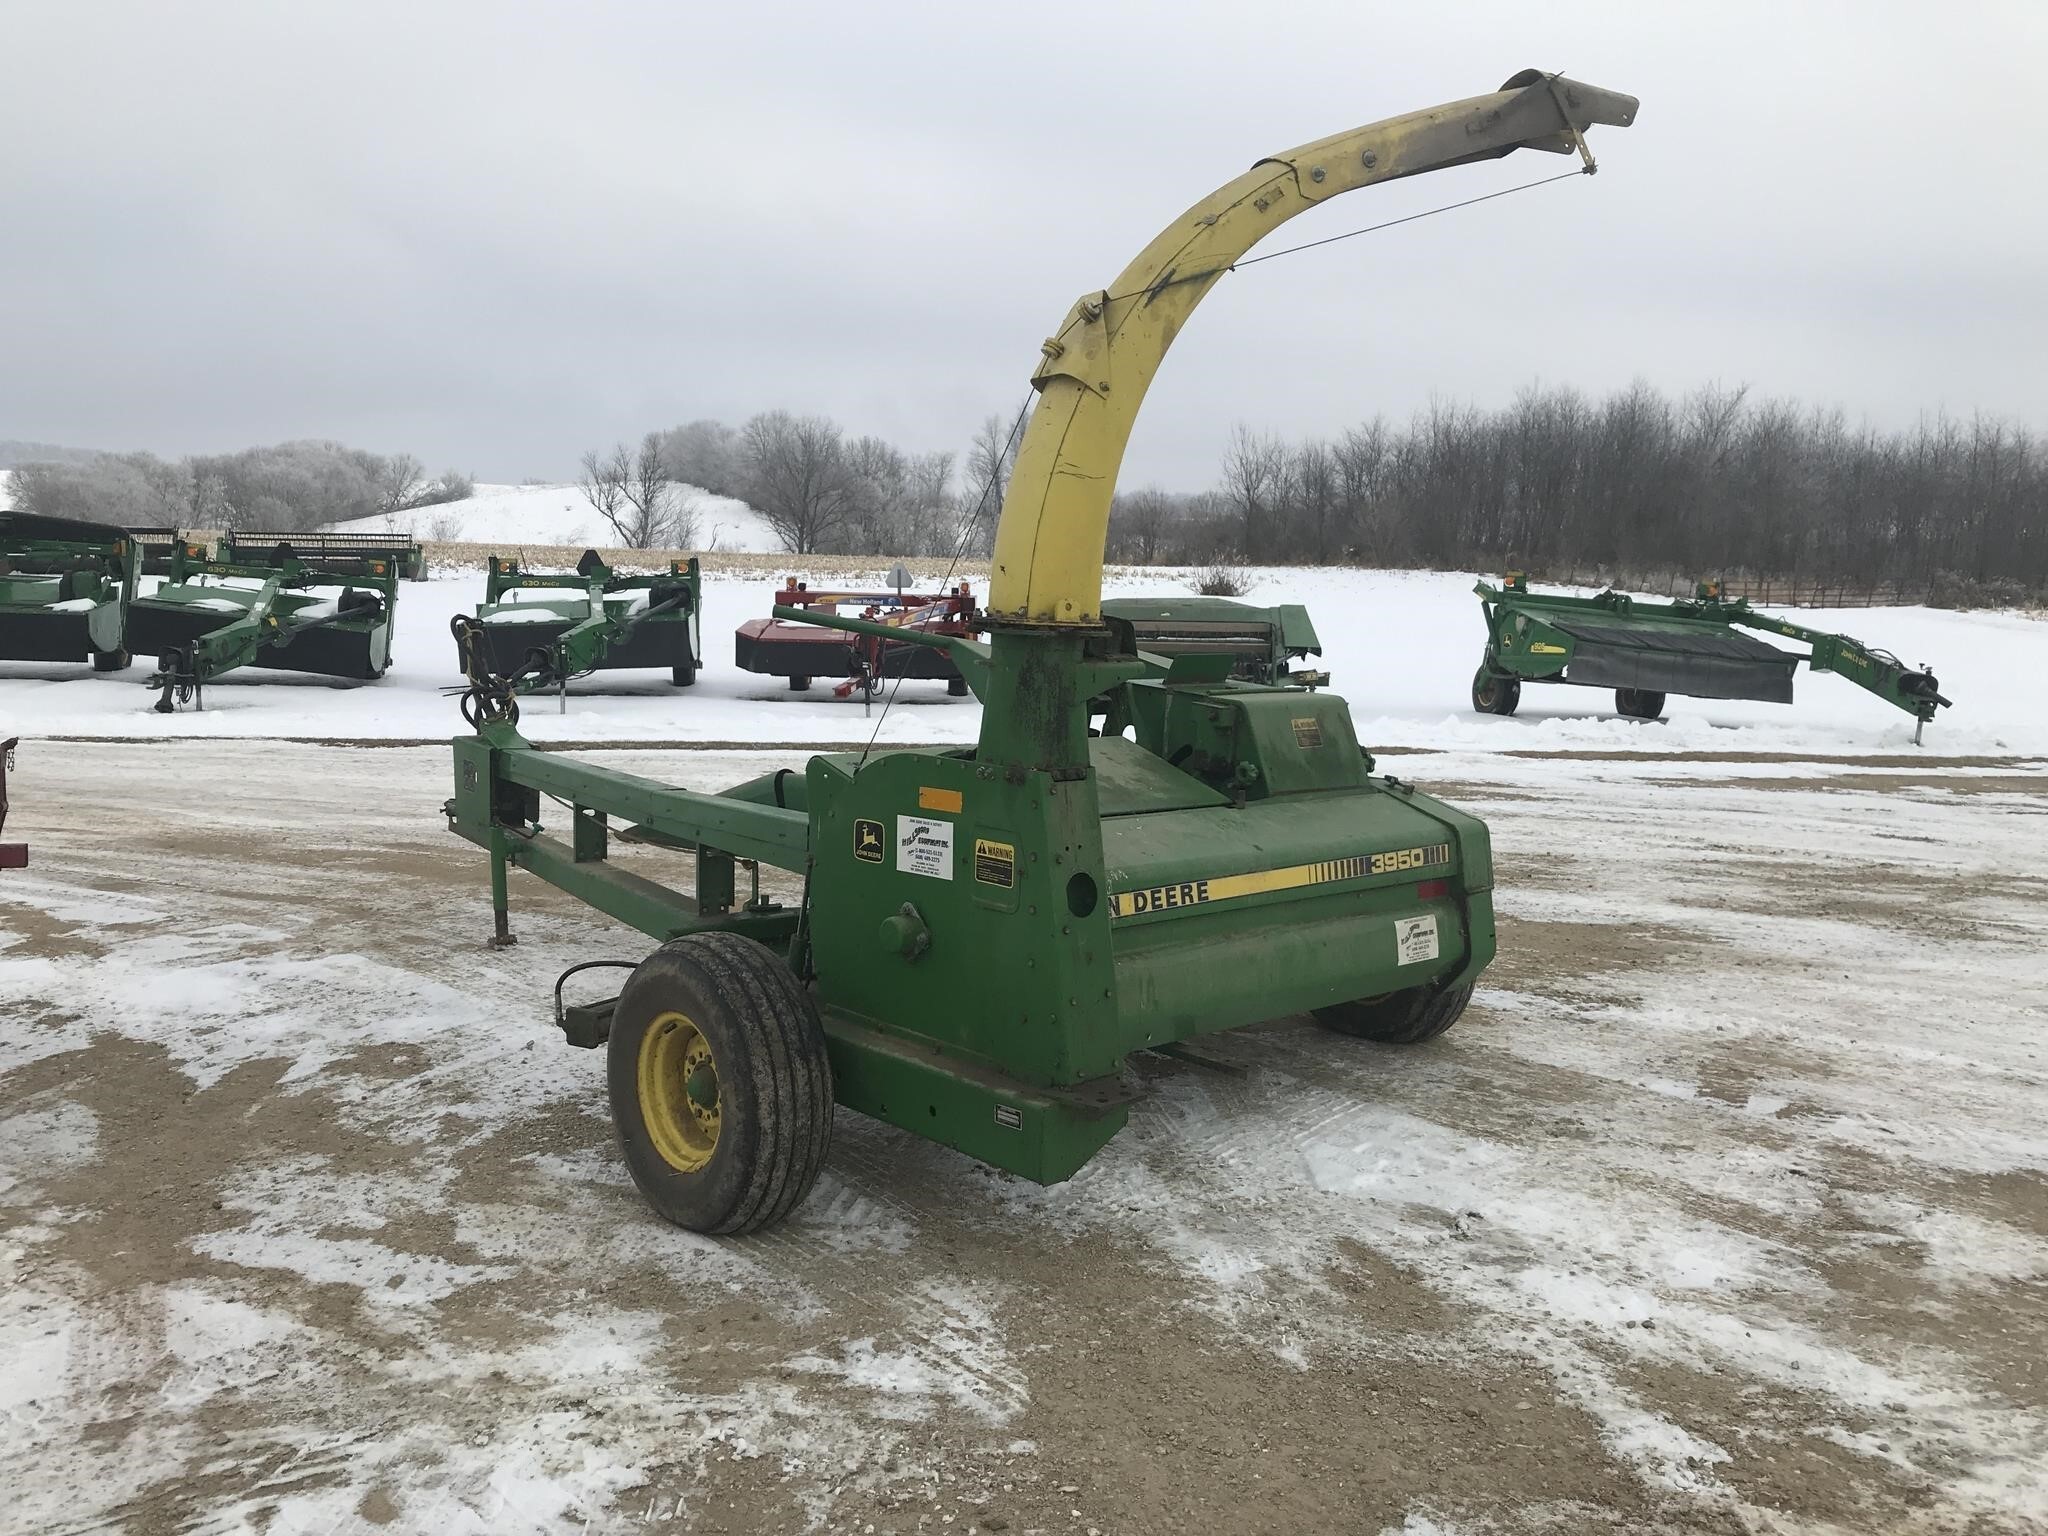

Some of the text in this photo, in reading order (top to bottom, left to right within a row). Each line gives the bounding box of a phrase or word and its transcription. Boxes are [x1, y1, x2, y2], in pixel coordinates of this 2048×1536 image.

[207, 566, 227, 574] 630
[849, 597, 884, 606] New Holland
[856, 848, 868, 856] JOHN
[987, 845, 1013, 861] WARNING
[1370, 847, 1424, 874] 3950
[1133, 881, 1209, 913] DEERE
